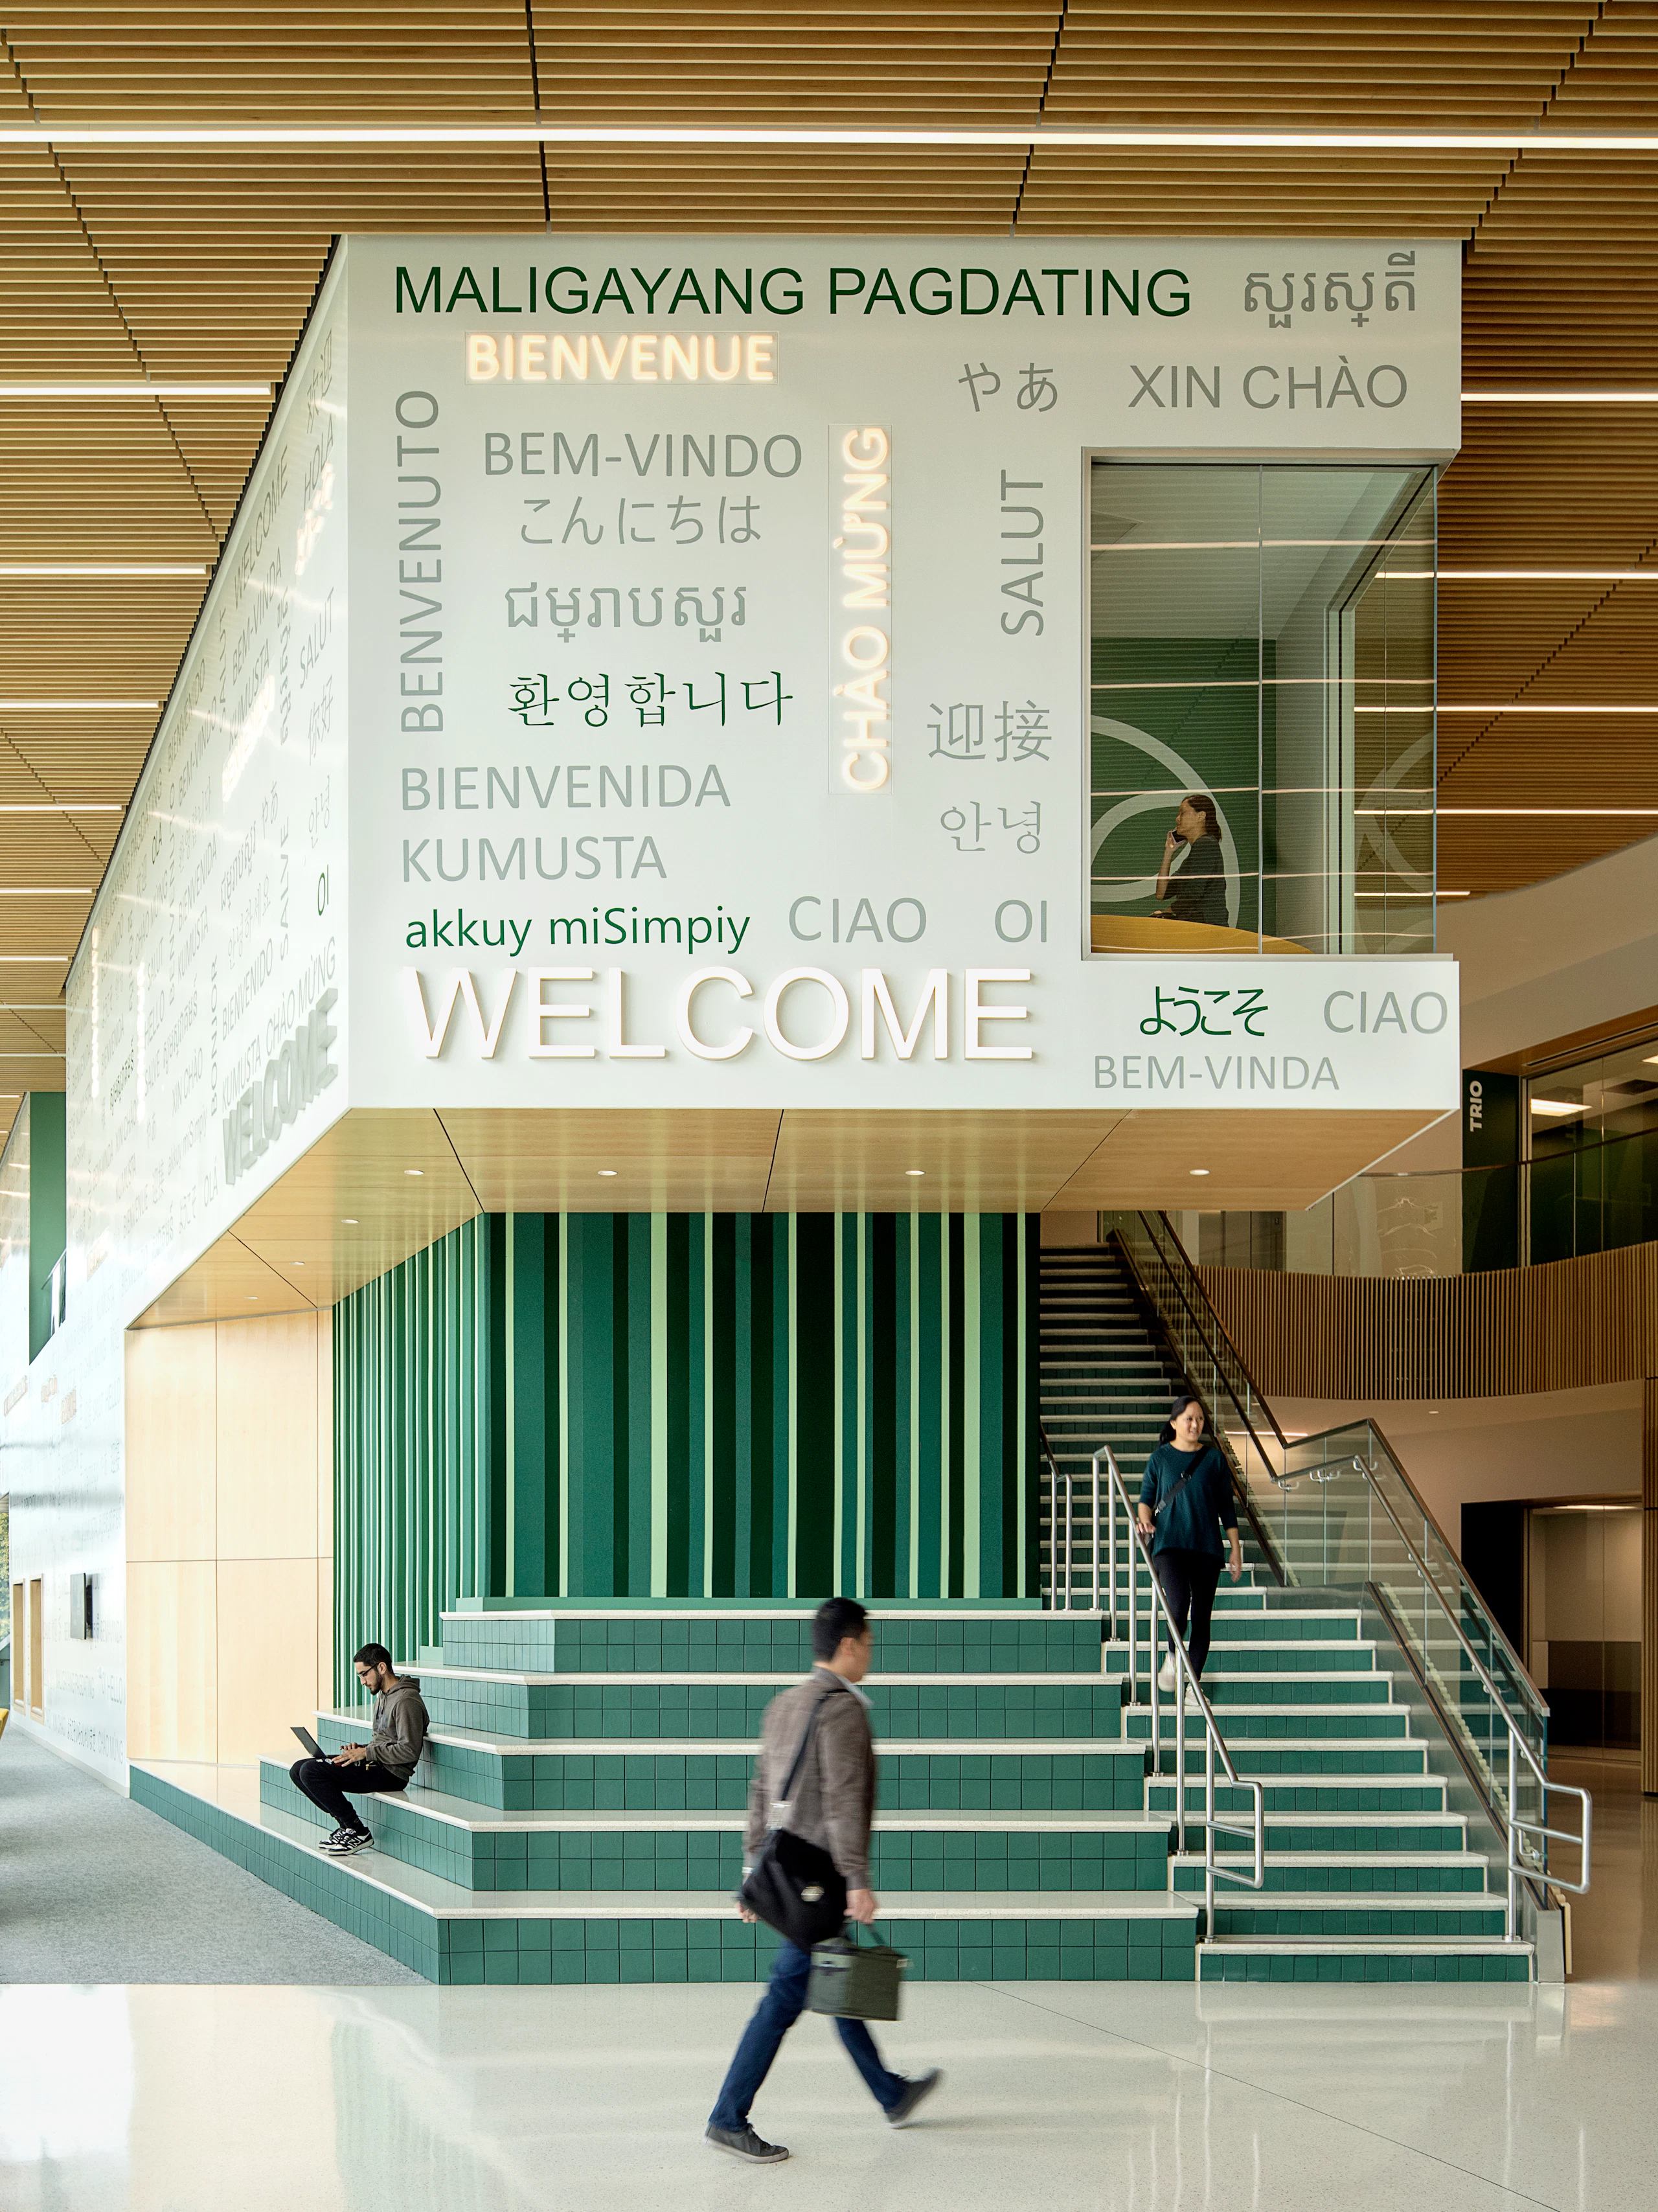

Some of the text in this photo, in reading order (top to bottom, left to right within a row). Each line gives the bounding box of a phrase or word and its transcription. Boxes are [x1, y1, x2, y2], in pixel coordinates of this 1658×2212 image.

[396, 266, 1190, 317] MALIGAYANG PAGDATING
[468, 334, 776, 382] BIENVENUE
[958, 361, 1058, 413] やあ
[1128, 355, 1407, 409] XIN CHÀO
[304, 413, 334, 511] HOLA
[484, 431, 802, 478] BEM-VINDO
[234, 445, 288, 610] WELCOME
[521, 495, 762, 545] こんにちは
[395, 391, 444, 733] BENVENUTO
[1000, 469, 1045, 637] SALUT
[233, 547, 282, 685] BEM-VINDA
[301, 586, 334, 689] SALUT
[834, 426, 891, 791] CHÀO MỪNG
[229, 639, 269, 751] KUMUSTA
[507, 670, 793, 728] 환영합니다
[179, 696, 217, 807] BEM-VINDO
[927, 699, 1053, 762] 迎接
[308, 775, 330, 849] 안녕
[402, 764, 731, 811] BIENVENIDA
[940, 801, 1042, 854] 안녕
[179, 832, 217, 933] BIENVENIDA
[280, 816, 289, 961] SALVE
[403, 836, 668, 883] KUMUSTA
[317, 863, 329, 916] OI
[789, 895, 927, 943] CIAO
[178, 905, 209, 985] KUMUSTA
[406, 905, 751, 957] akkuy miSimpiy
[994, 899, 1047, 943] OI
[223, 937, 273, 1042] BIENVENIDO
[403, 966, 1034, 1062] WELCOME
[1140, 985, 1269, 1038] ようこそ
[1323, 990, 1448, 1034] CIAO
[144, 990, 165, 1050] HELLO
[222, 1034, 262, 1114] KUMUSTA
[266, 989, 295, 1057] CHÀO
[1095, 1055, 1341, 1090] BEM-VINDA
[223, 987, 338, 1185] WELCOME
[1470, 1080, 1483, 1132] TRIO
[204, 1156, 218, 1207] OLÁ
